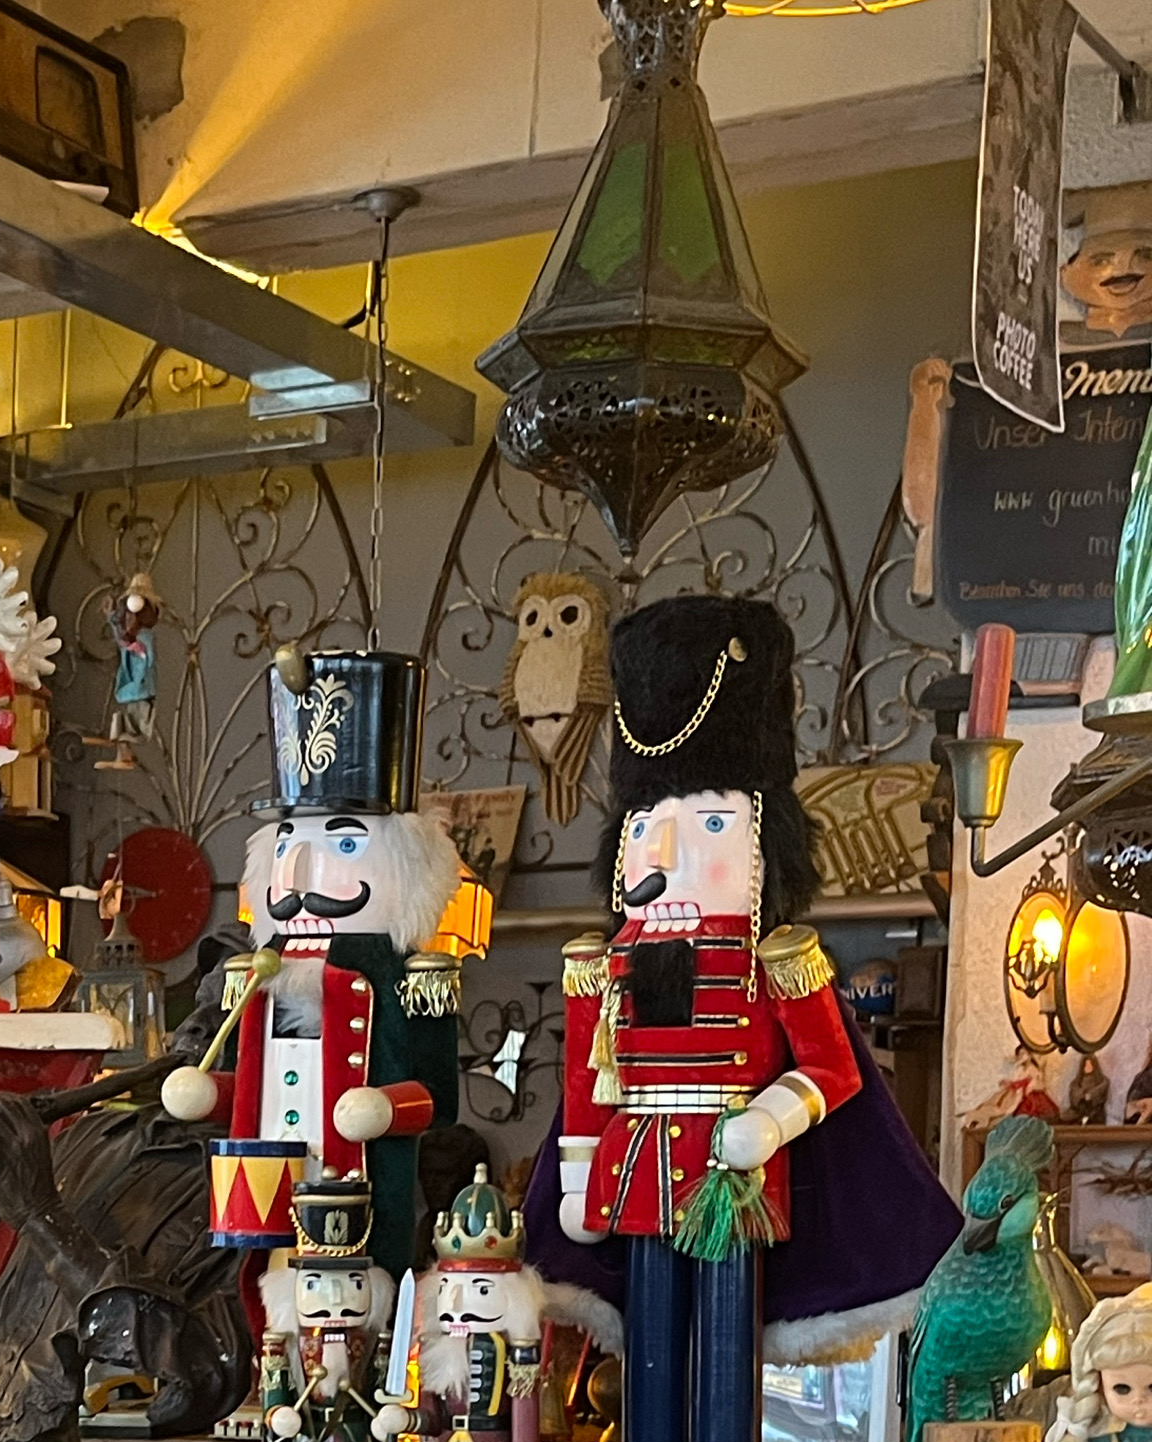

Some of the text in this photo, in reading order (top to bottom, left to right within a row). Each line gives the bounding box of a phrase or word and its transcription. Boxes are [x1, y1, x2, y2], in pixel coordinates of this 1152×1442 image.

[1018, 249, 1032, 284] US
[996, 311, 1036, 360] PHOTO
[993, 340, 1033, 390] COFFEE
